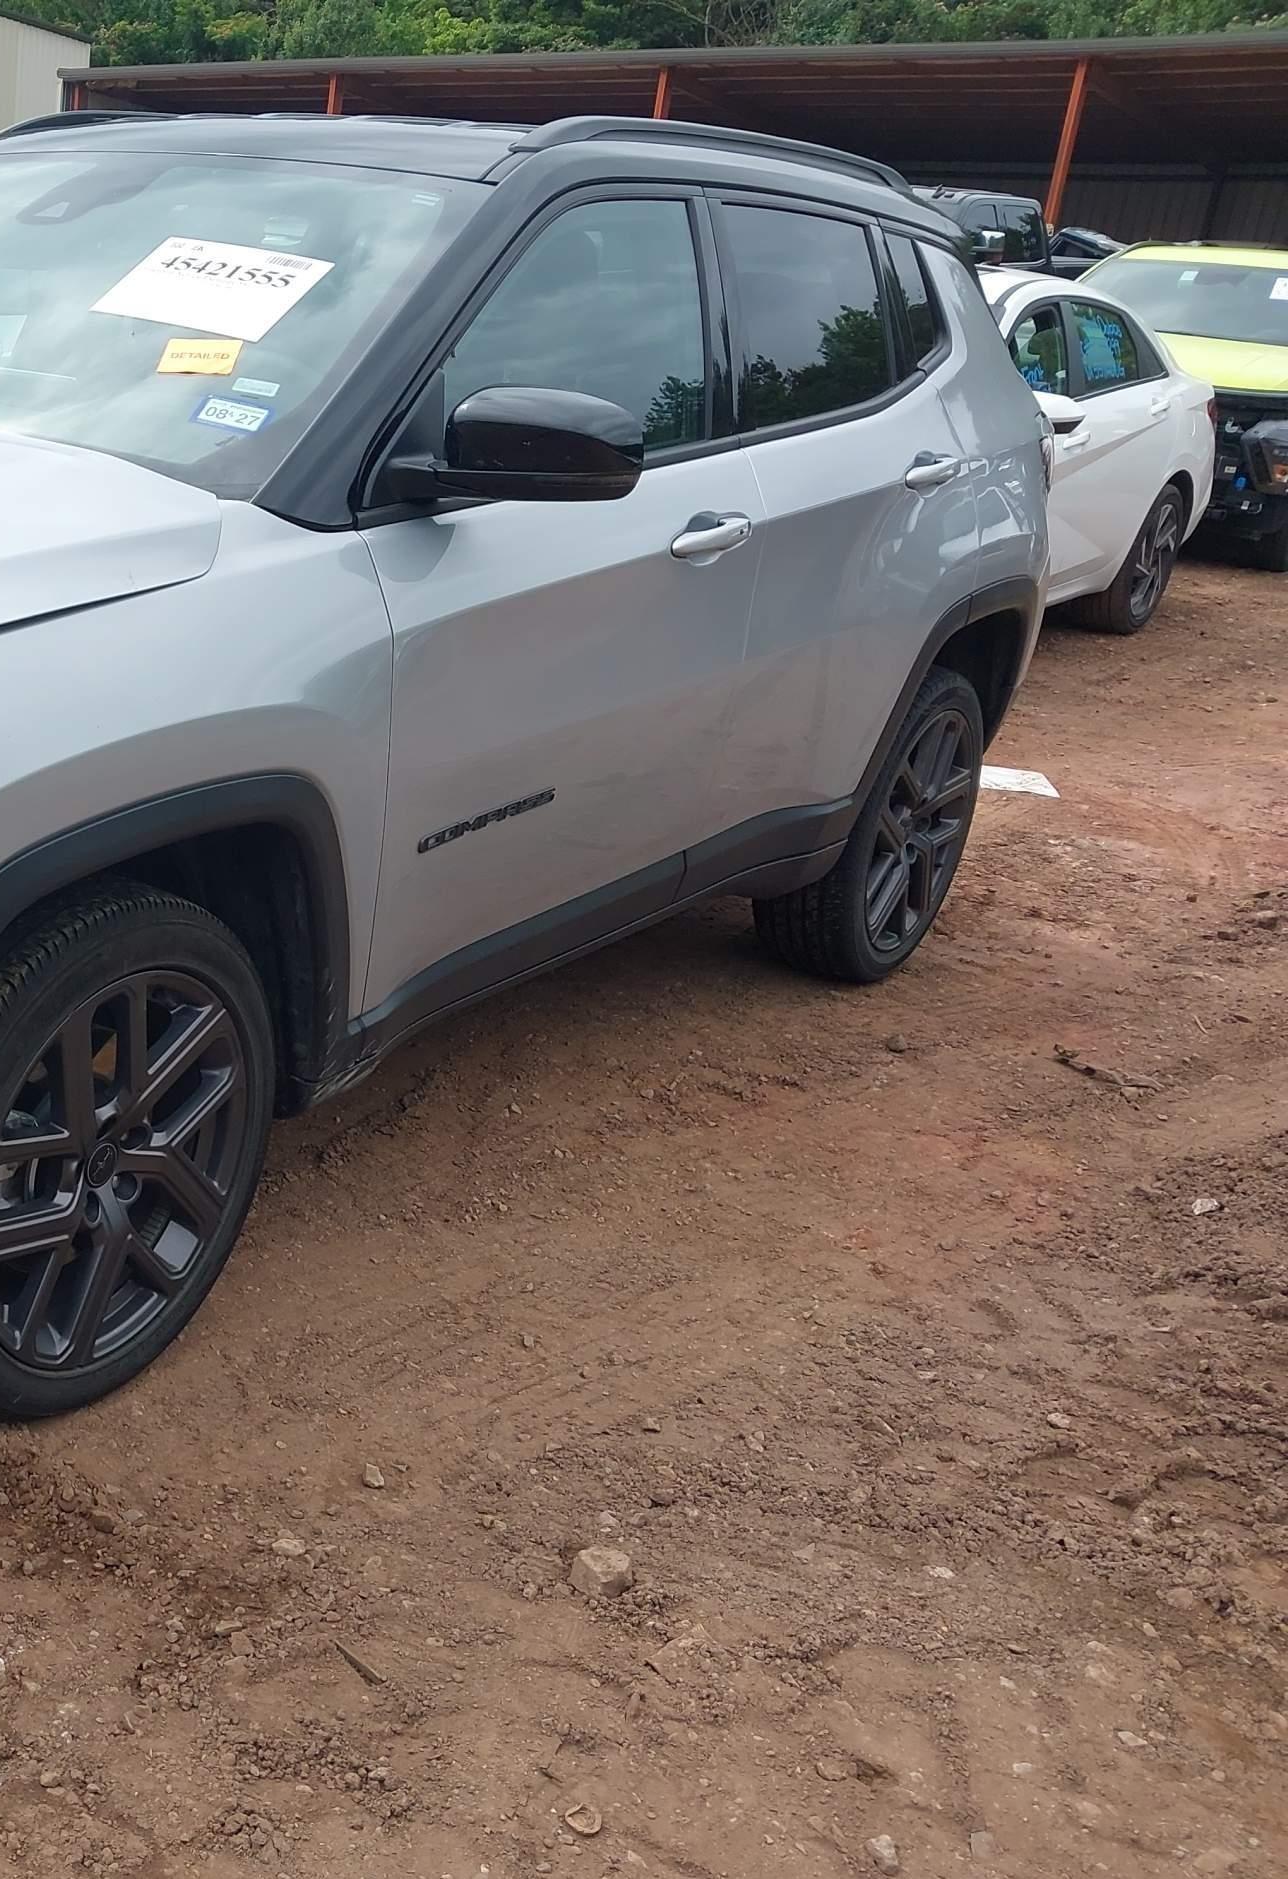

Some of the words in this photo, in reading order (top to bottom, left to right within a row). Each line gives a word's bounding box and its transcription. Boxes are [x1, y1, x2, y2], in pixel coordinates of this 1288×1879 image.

[160, 255, 297, 288] 45421555
[169, 351, 231, 361] DETAILED
[204, 406, 229, 420] 08
[233, 412, 261, 426] 27
[417, 785, 556, 855] COMPASS
